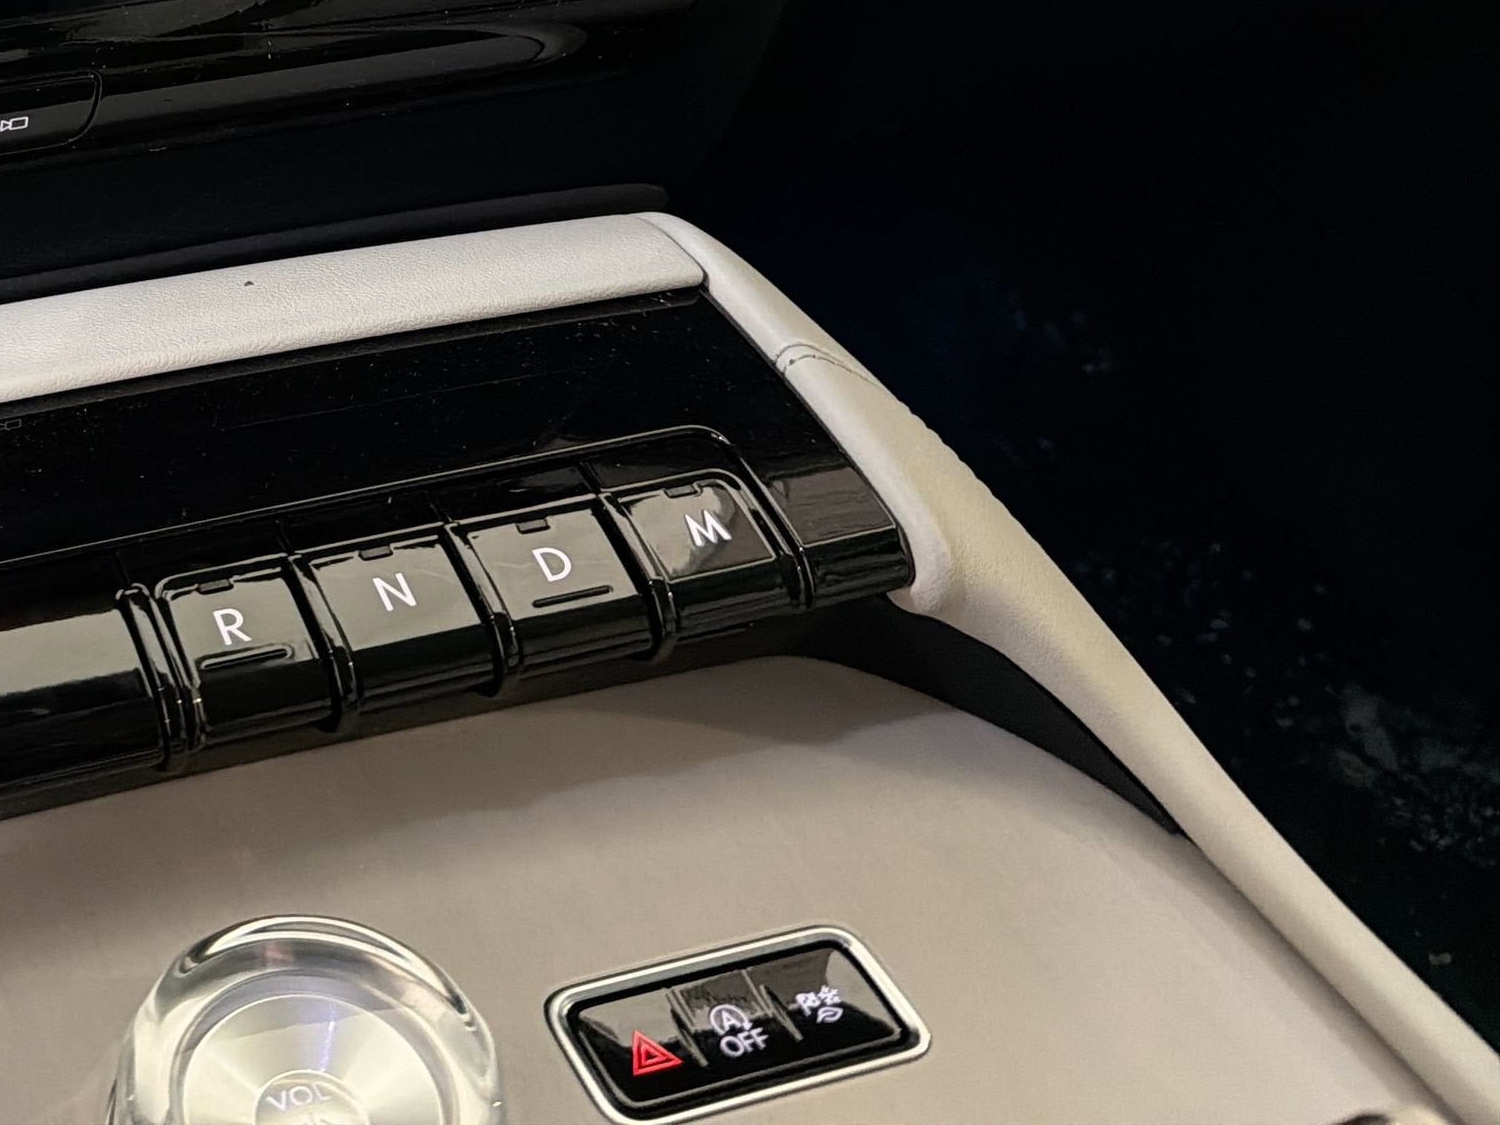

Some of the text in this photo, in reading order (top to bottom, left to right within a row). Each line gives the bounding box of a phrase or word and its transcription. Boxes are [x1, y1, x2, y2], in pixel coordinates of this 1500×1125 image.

[684, 512, 732, 547] M
[534, 547, 572, 582] D
[373, 573, 417, 612] N
[213, 608, 252, 646] R
[719, 1027, 769, 1058] OFF
[265, 1085, 332, 1112] VOL
